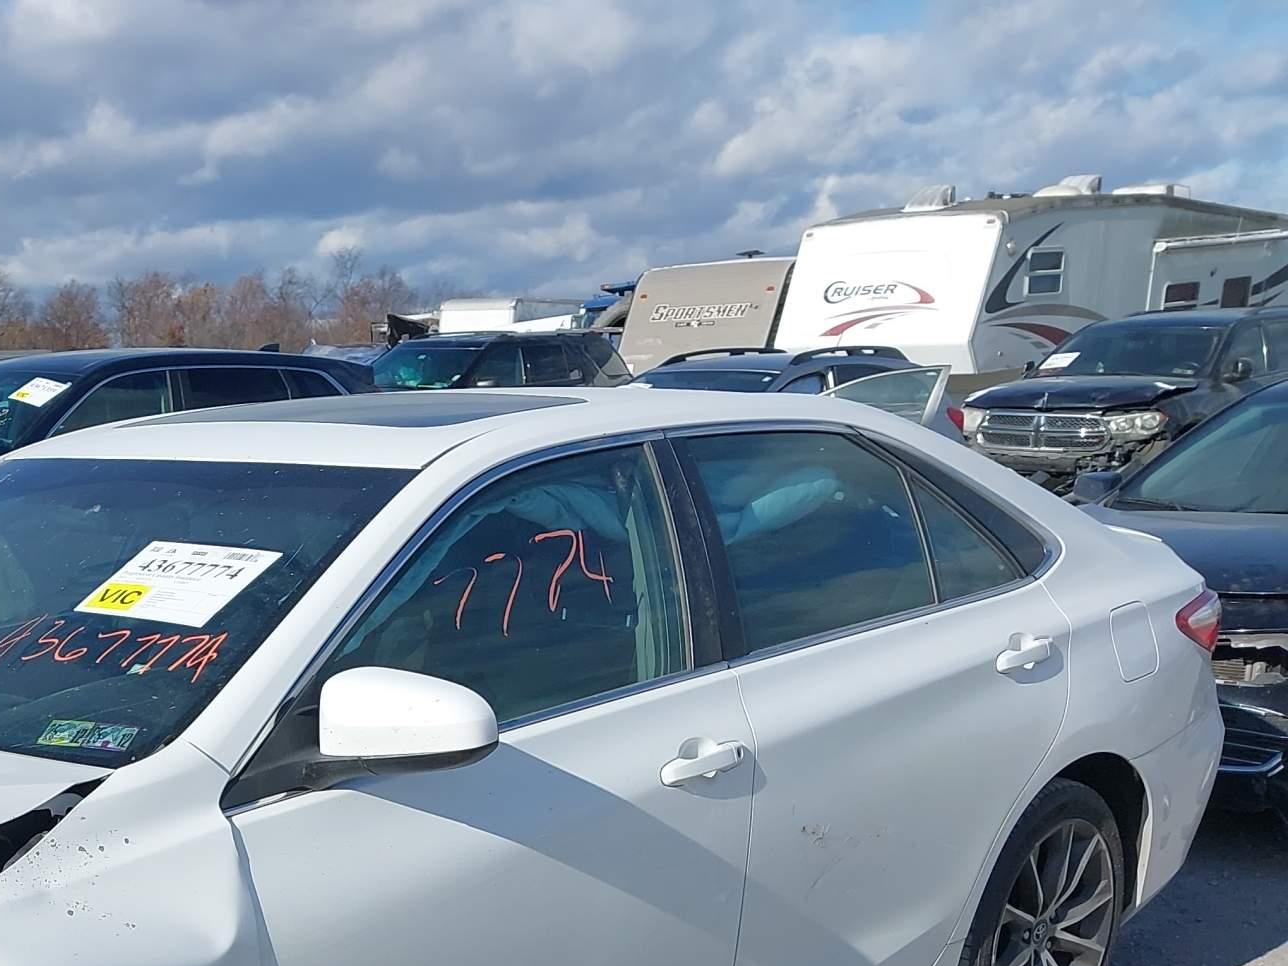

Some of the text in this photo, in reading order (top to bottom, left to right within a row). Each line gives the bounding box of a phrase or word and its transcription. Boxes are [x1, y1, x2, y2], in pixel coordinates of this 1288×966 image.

[823, 280, 898, 304] CRUISER
[649, 303, 751, 323] SPORTSMEN
[138, 558, 245, 580] 43677774
[433, 529, 614, 636] 7774
[98, 588, 142, 605] VIC
[117, 732, 134, 748] 12
